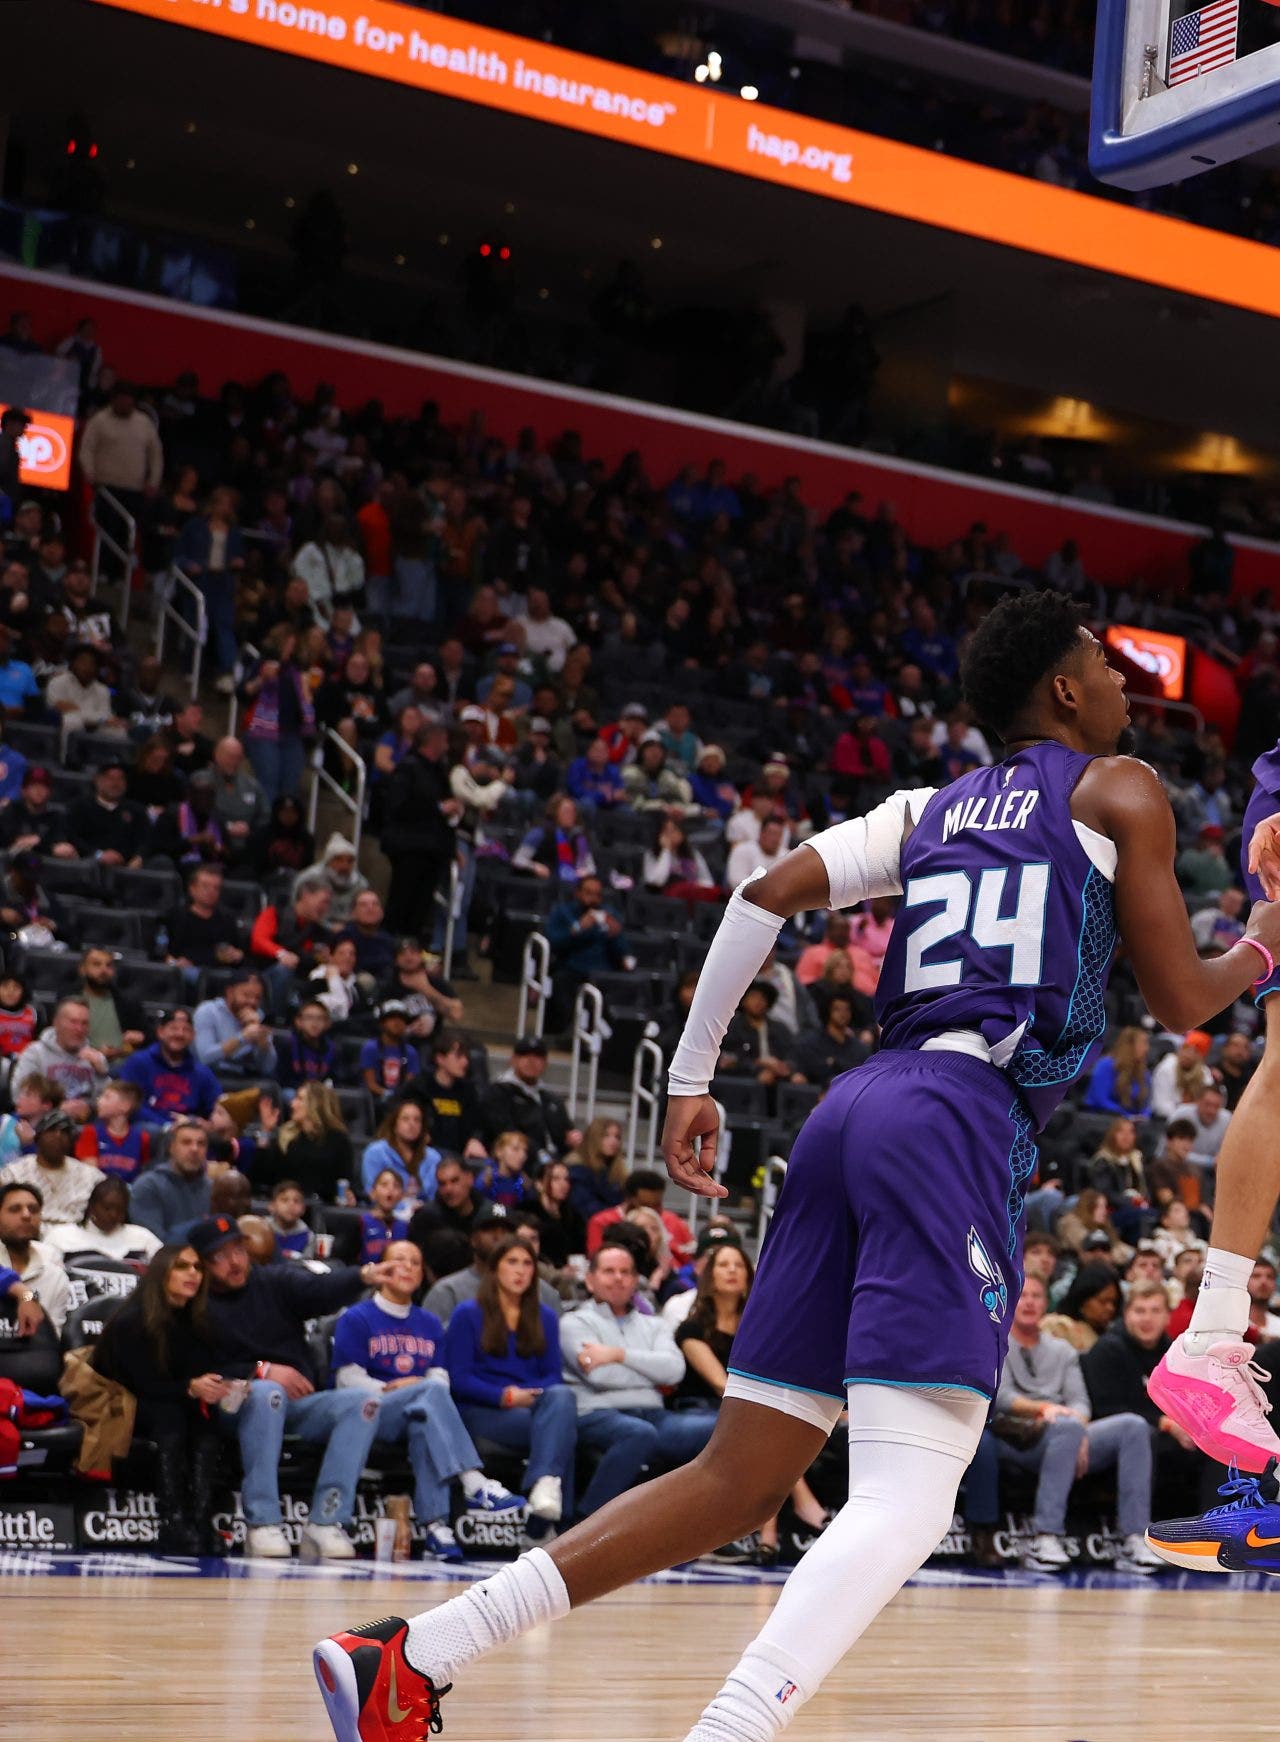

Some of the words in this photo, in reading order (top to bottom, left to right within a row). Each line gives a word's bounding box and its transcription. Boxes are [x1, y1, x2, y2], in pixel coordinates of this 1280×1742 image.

[353, 15, 404, 54] for
[408, 30, 507, 85] health
[747, 123, 853, 183] hap.org
[942, 789, 1040, 845] MILLER
[904, 861, 1051, 994] 24
